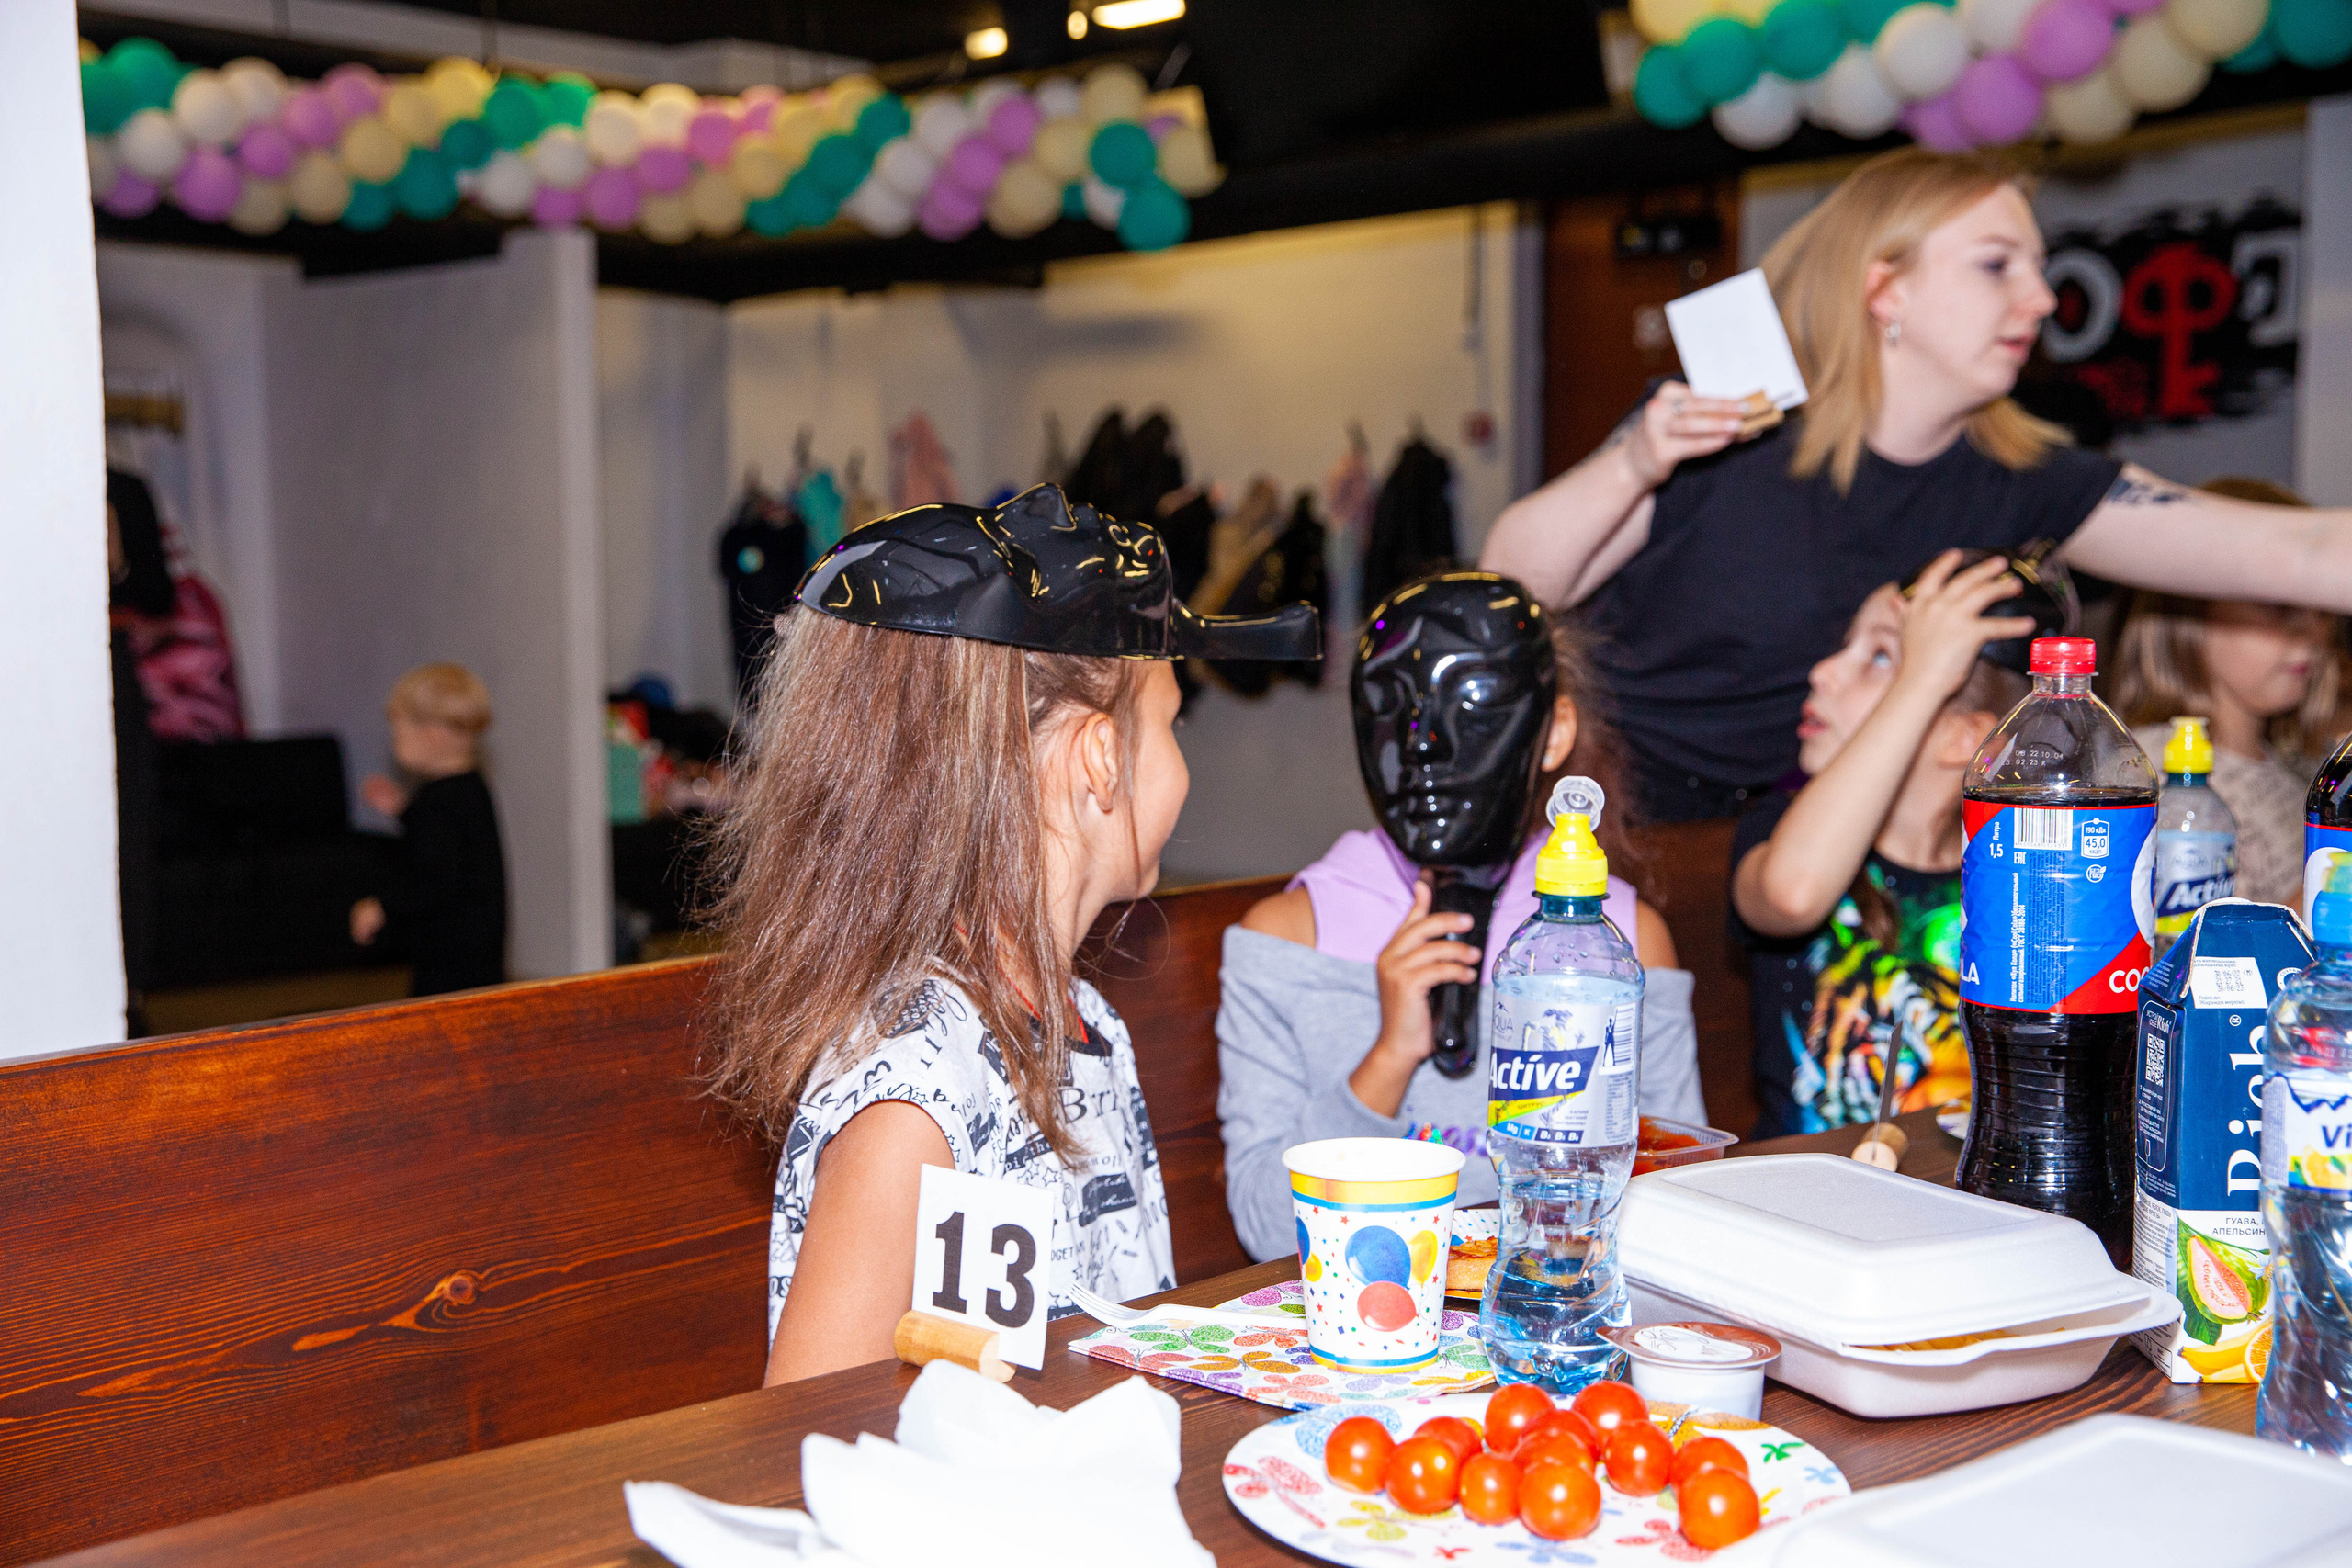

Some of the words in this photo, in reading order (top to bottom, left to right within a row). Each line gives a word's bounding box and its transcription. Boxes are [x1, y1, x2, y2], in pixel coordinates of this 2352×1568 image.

[2085, 826, 2096, 834] 190
[2085, 838, 2106, 848] 45,0
[1989, 842, 2004, 859] 1,5
[1507, 1122, 1519, 1135] Mg
[2225, 1217, 2259, 1225] ГУАВА,
[932, 1211, 1037, 1328] 13
